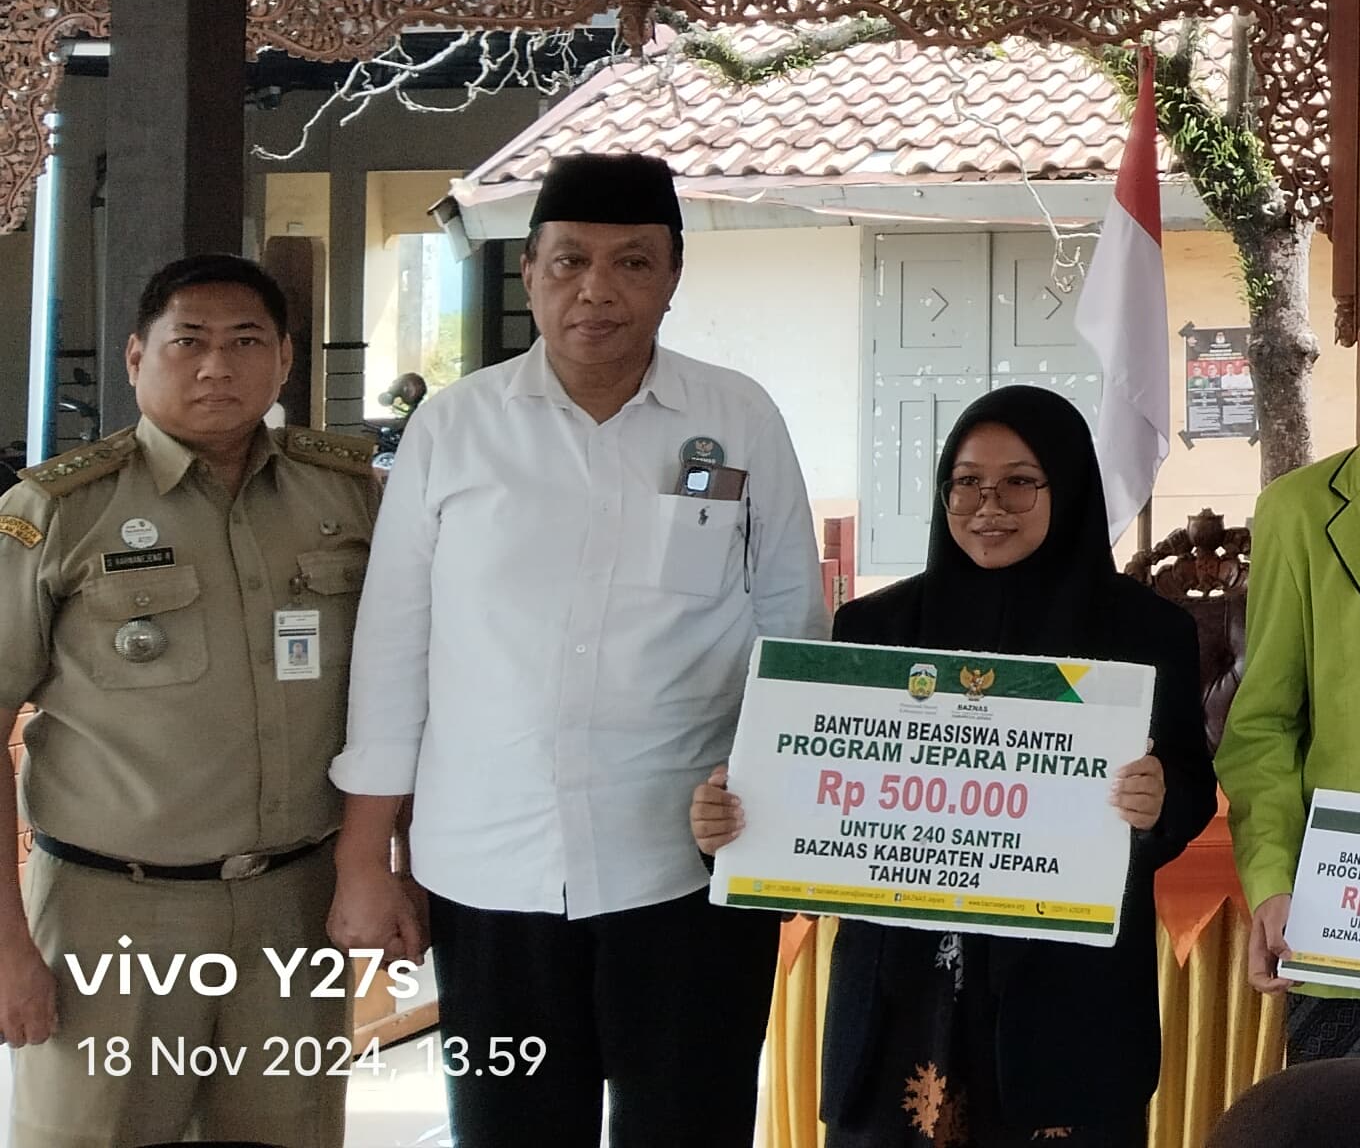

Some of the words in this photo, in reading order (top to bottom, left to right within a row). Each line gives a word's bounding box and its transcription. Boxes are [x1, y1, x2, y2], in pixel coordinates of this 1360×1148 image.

[814, 714, 901, 739] BANTUAN
[907, 721, 1000, 747] BEASISWA
[1006, 729, 1073, 751] SANTRI
[777, 734, 903, 762] PROGRAM
[910, 746, 1007, 771] JEPARA
[1017, 753, 1109, 778] PINTAR
[817, 770, 865, 815] Rp
[878, 775, 1028, 819] 500.000
[841, 820, 907, 841] UNTUK
[912, 825, 946, 845] 240
[951, 829, 1021, 849] SANTRI
[794, 838, 868, 859] BAZNAS
[874, 844, 984, 868] KABUPATEN
[989, 853, 1059, 874] JEPARA
[869, 865, 932, 885] TAHUN
[937, 870, 981, 889] 2024
